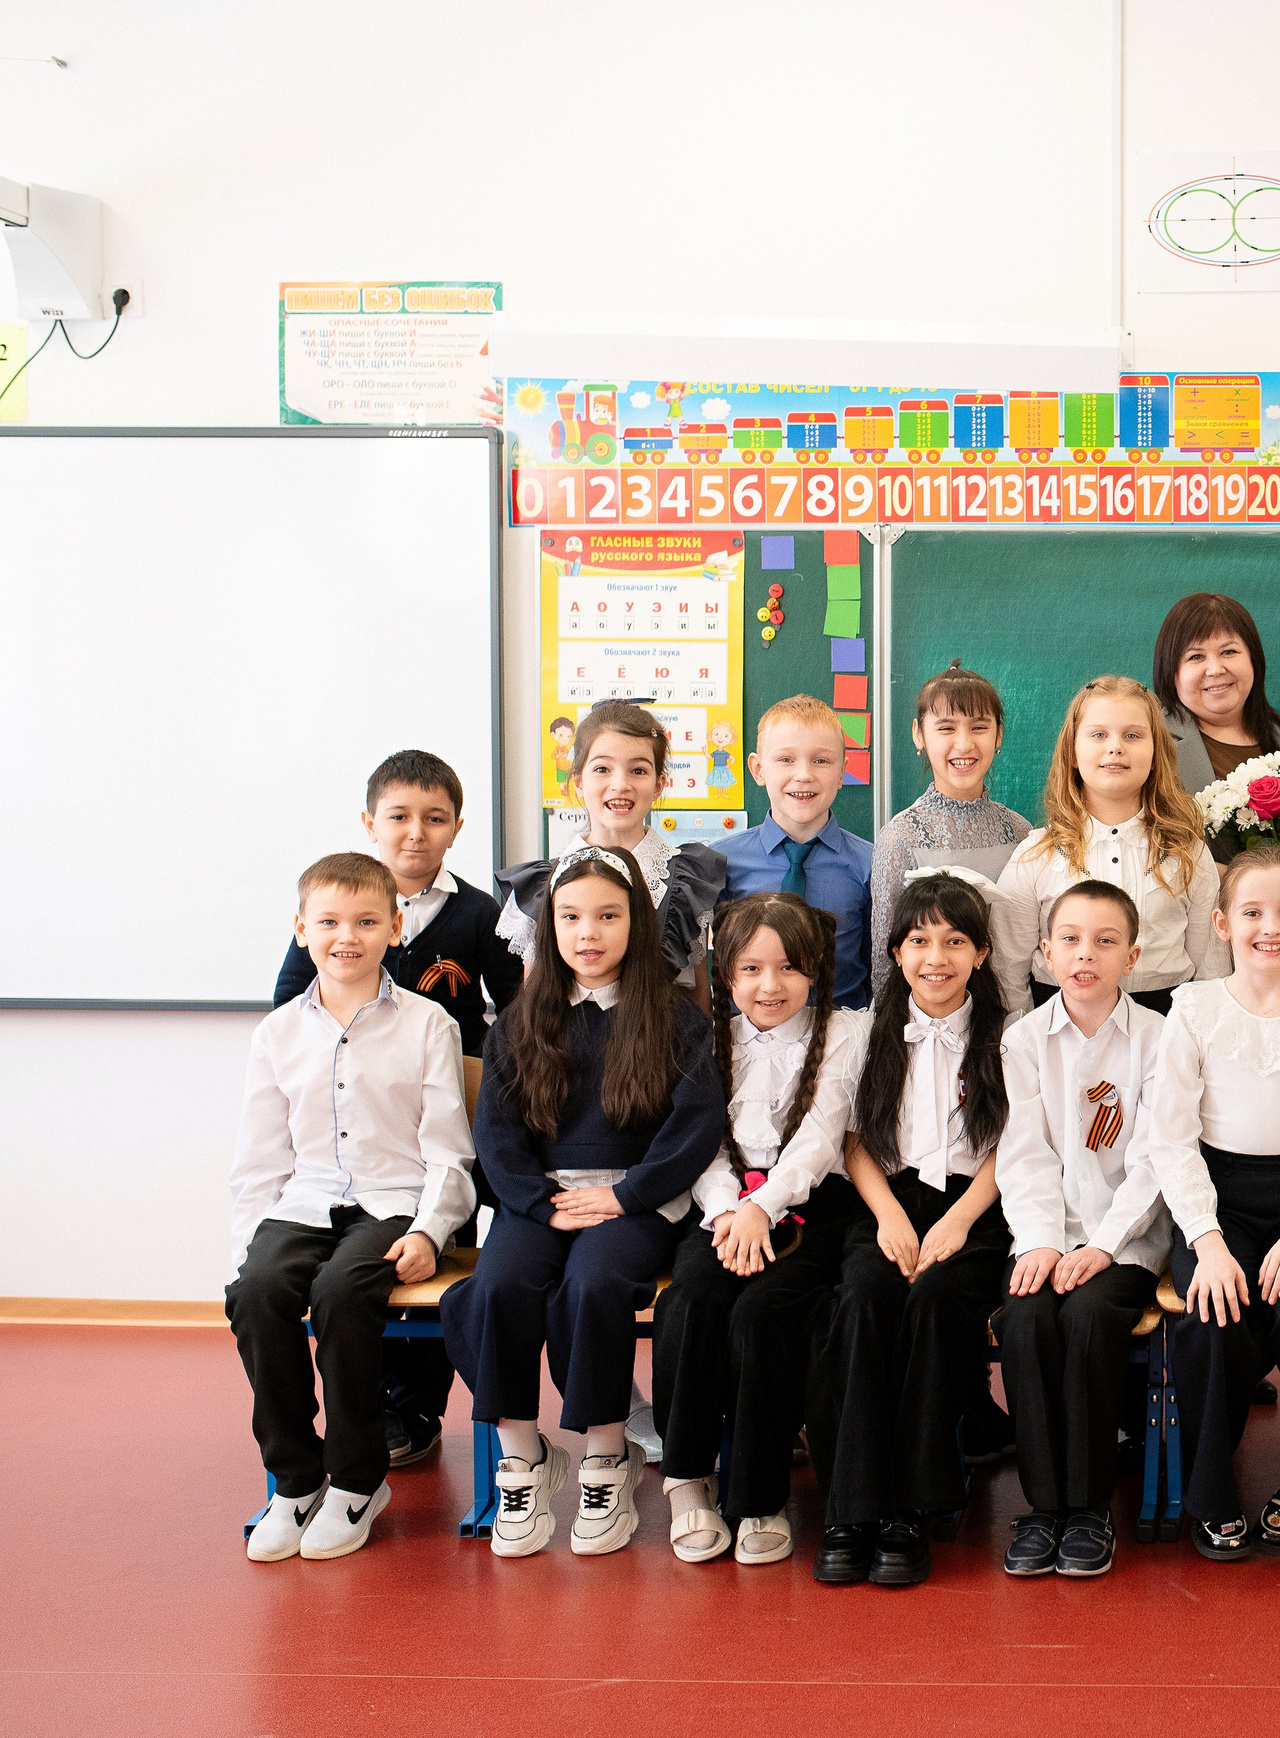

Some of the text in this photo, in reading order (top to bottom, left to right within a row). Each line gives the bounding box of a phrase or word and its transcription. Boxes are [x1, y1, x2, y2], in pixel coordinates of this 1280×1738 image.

[286, 289, 494, 311] ПИШЕМ БЕЗ ОШИБОК
[328, 319, 448, 327] ОПАСНЫЕ СОЧЕТАНИЯ
[300, 328, 407, 340] ЖИ-ШИ пиши буквой
[303, 338, 407, 350] ЧА-ЩА пиши буквой
[304, 350, 337, 360] ЧУ-ЩУ
[373, 349, 407, 360] буквой
[322, 379, 447, 391] ОРО ОЛО пиши буквой
[1138, 376, 1151, 386] 10
[1178, 377, 1256, 386] Основные операции
[975, 394, 983, 405] 7
[920, 401, 928, 411] 6
[865, 407, 873, 417] 5
[753, 417, 761, 428] 3
[808, 413, 816, 423] 4
[699, 424, 707, 433] 2
[1185, 420, 1249, 429] Знаки сравнения
[516, 477, 544, 518] 0
[557, 477, 576, 518] 1
[589, 475, 617, 518] 2
[625, 475, 653, 518] 3
[659, 476, 691, 518] 4
[698, 476, 726, 518] 5
[732, 474, 763, 518] 6
[769, 475, 798, 517] 7
[806, 474, 836, 517] 8
[844, 474, 874, 517] 9
[877, 474, 913, 517] 10
[915, 475, 949, 517] 11
[952, 475, 988, 517] 12
[988, 475, 1024, 517] 13
[1026, 475, 1061, 516] 14
[1062, 475, 1097, 516] 15
[1099, 474, 1135, 516] 16
[1136, 474, 1172, 516] 17
[1173, 474, 1209, 516] 18
[1210, 473, 1245, 516] 19
[589, 536, 702, 549] ГЛАСНЫЕ ЗВУКИ
[590, 552, 702, 564] русского языка
[606, 583, 678, 593] Обозначают звук
[570, 602, 719, 614] А О У Э И Ы
[604, 648, 681, 658] Обозначают 2 звука
[576, 664, 709, 679] Е Ё Ю Я
[685, 731, 694, 741] Е
[687, 778, 697, 789] Э
